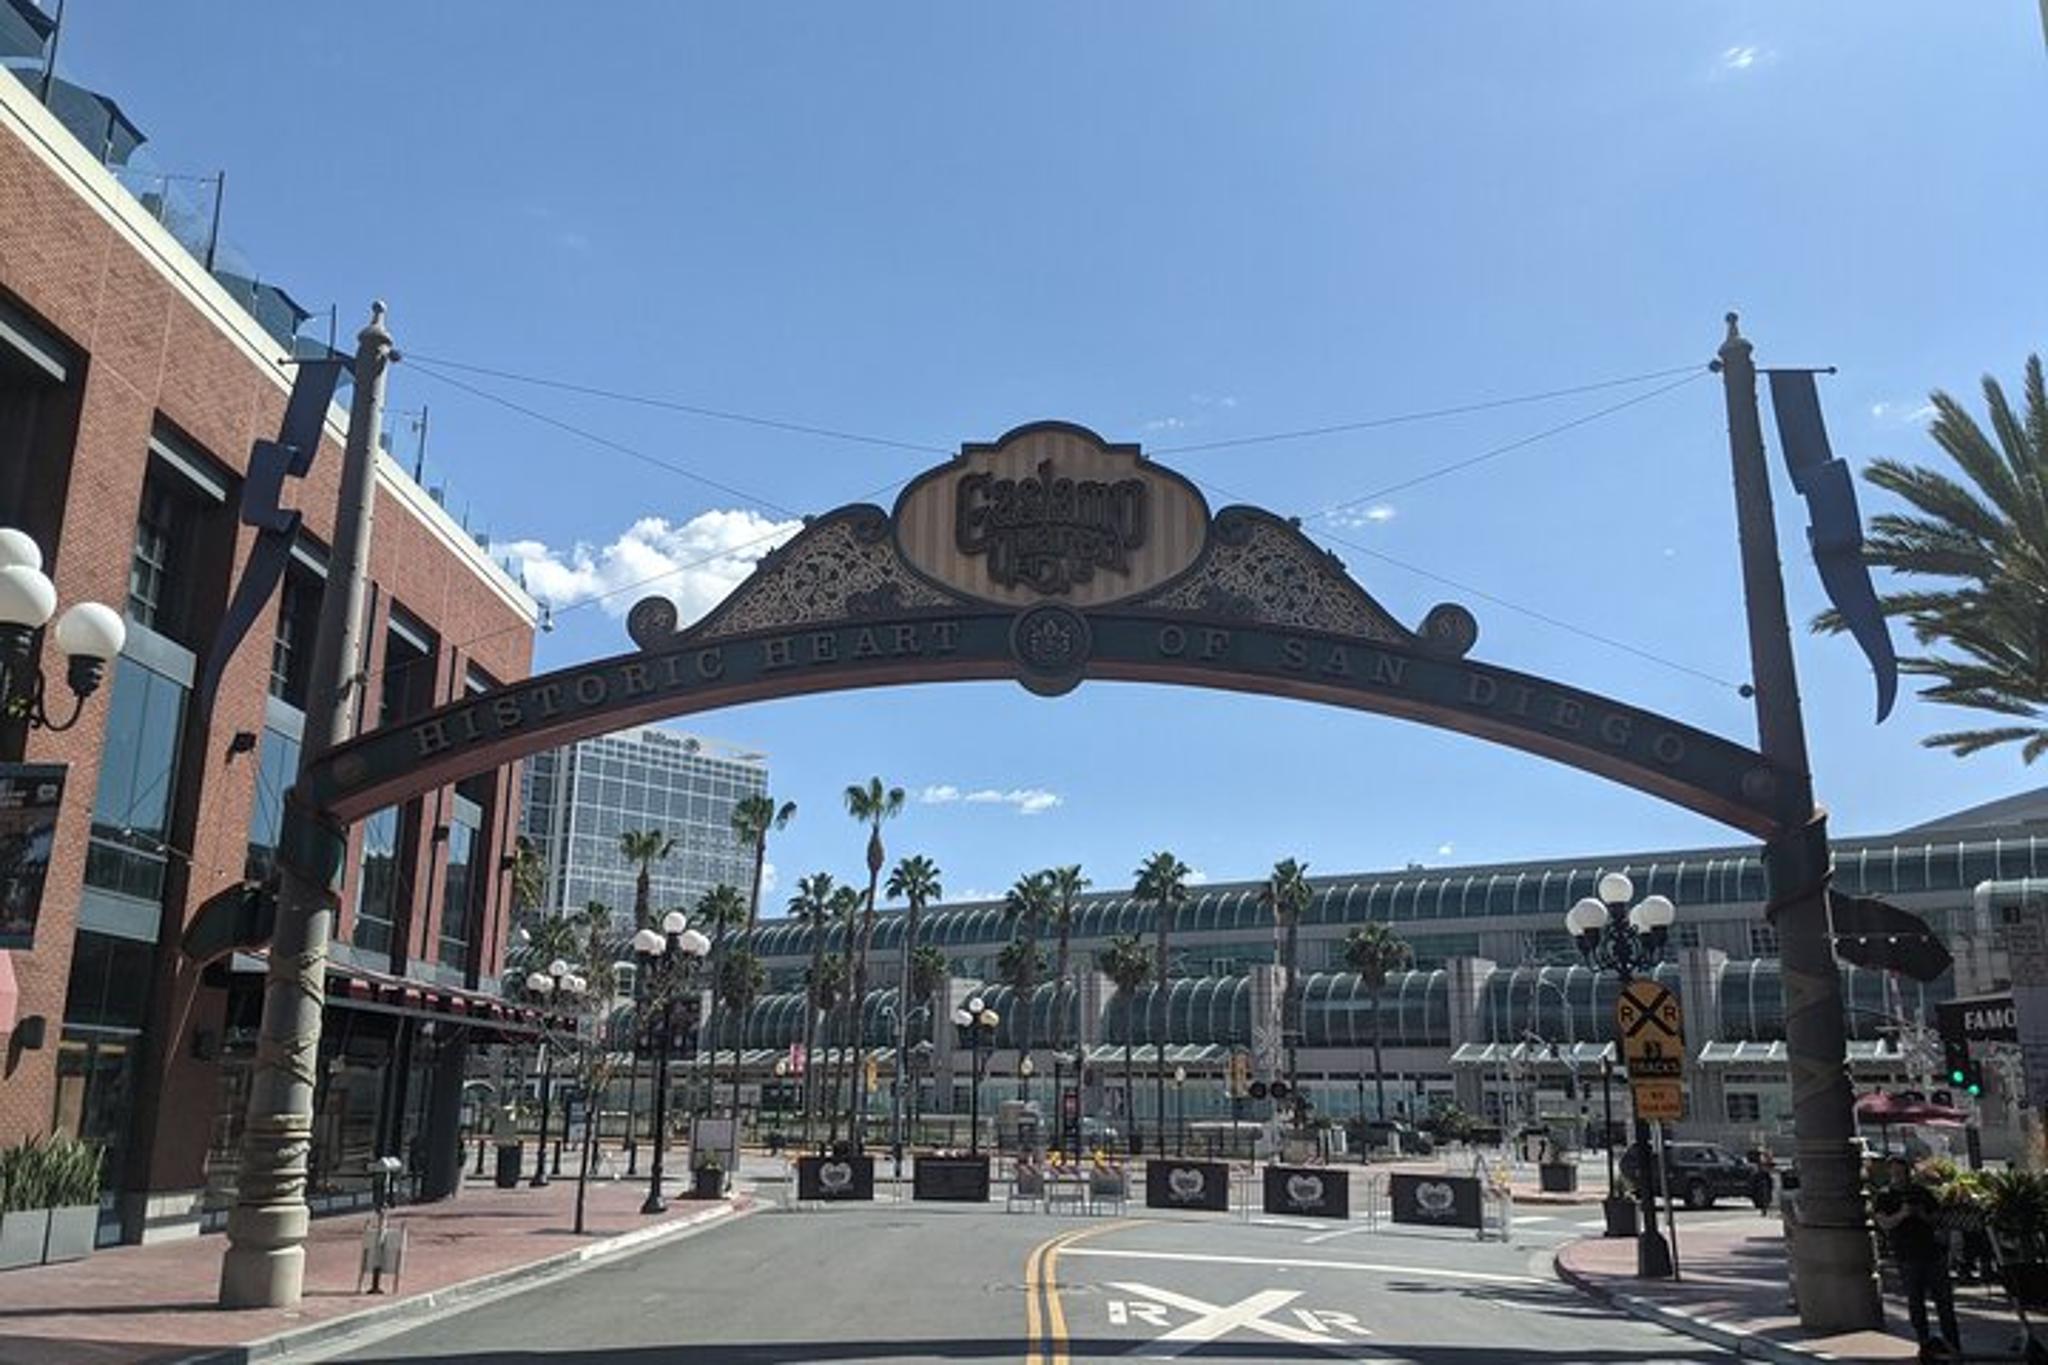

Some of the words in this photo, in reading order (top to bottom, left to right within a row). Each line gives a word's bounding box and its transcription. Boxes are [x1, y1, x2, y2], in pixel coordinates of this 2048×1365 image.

[412, 649, 725, 752] HISTORIC
[761, 622, 960, 668] HEART
[1158, 625, 1231, 659] OF
[1280, 638, 1411, 685] SAN
[1463, 672, 1686, 764] DIEGO
